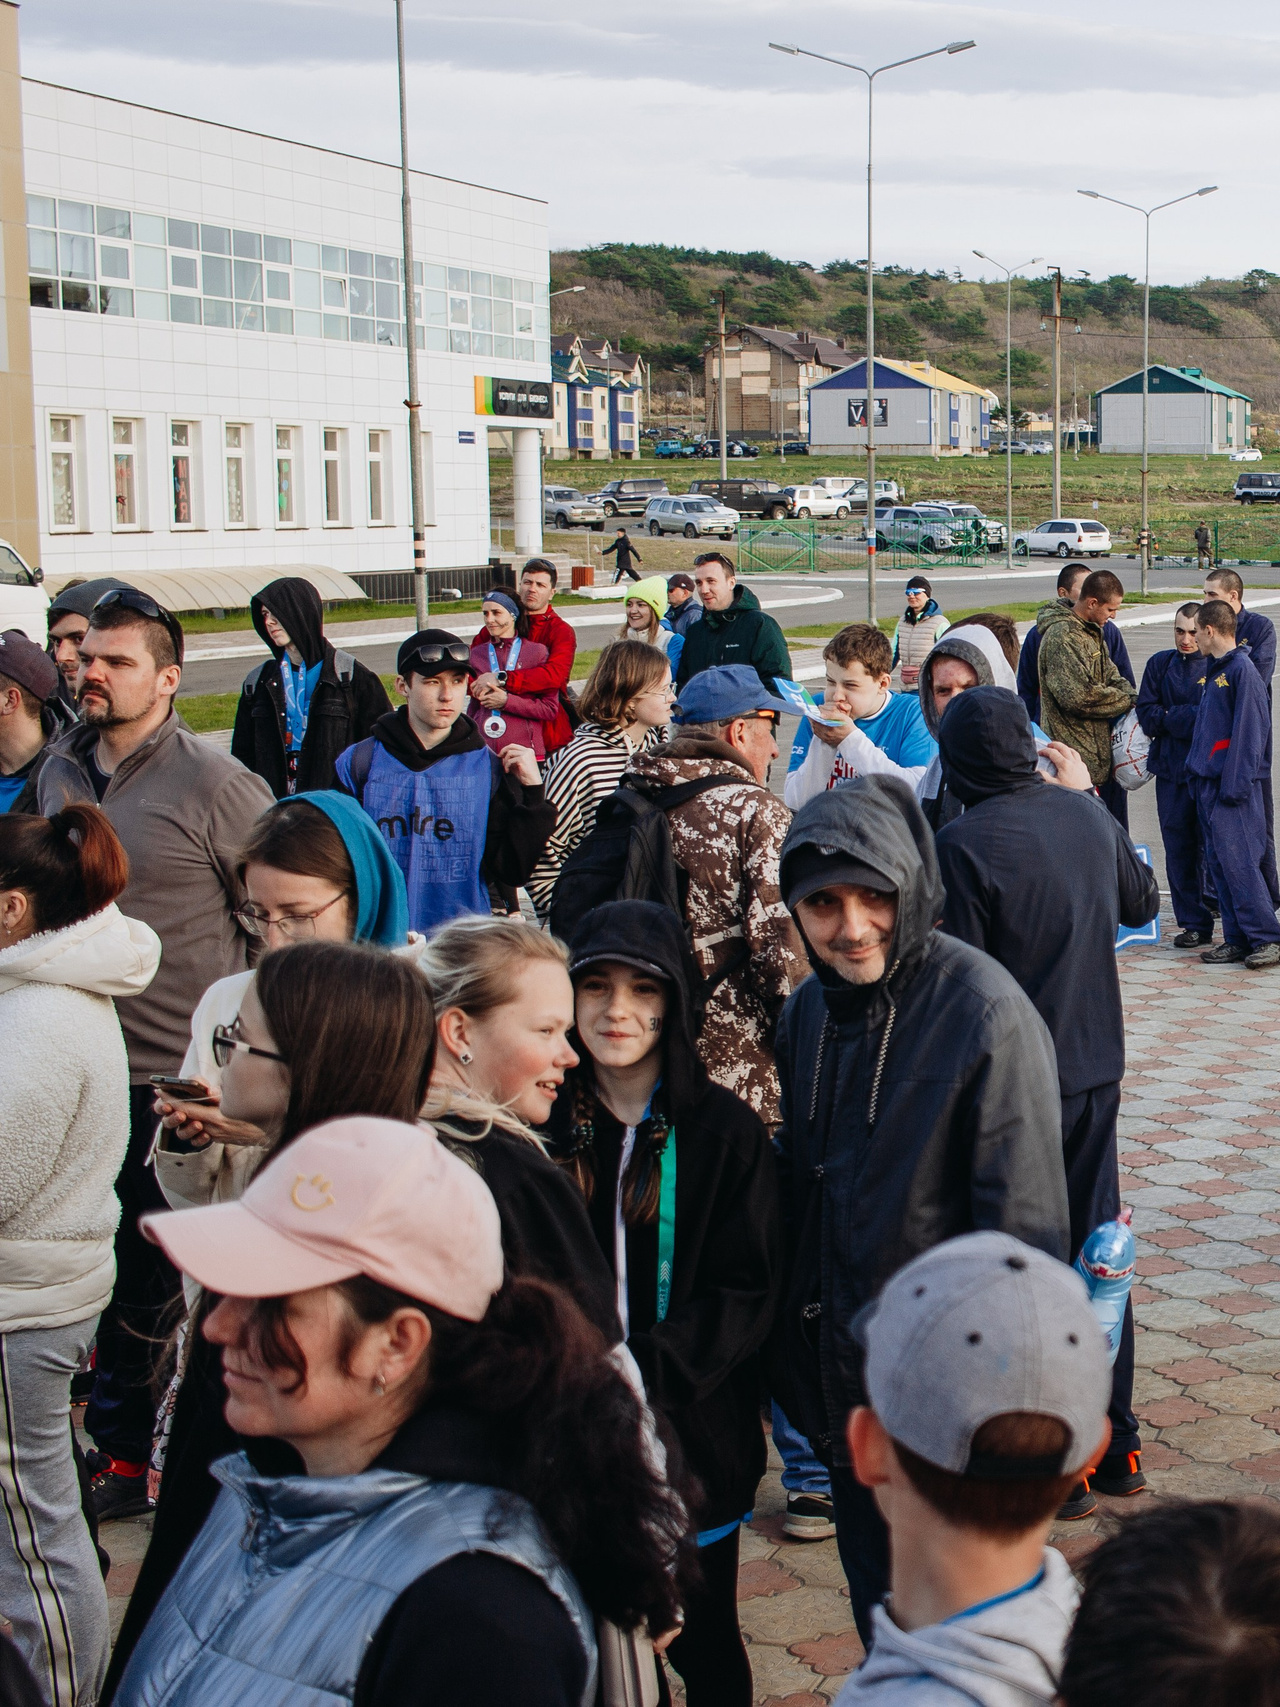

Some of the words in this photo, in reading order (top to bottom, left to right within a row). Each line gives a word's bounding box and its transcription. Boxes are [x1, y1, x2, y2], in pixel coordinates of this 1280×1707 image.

[517, 393, 527, 403] ДЛЯ
[850, 406, 864, 422] V
[791, 745, 805, 755] СБ
[376, 805, 455, 841] mtre
